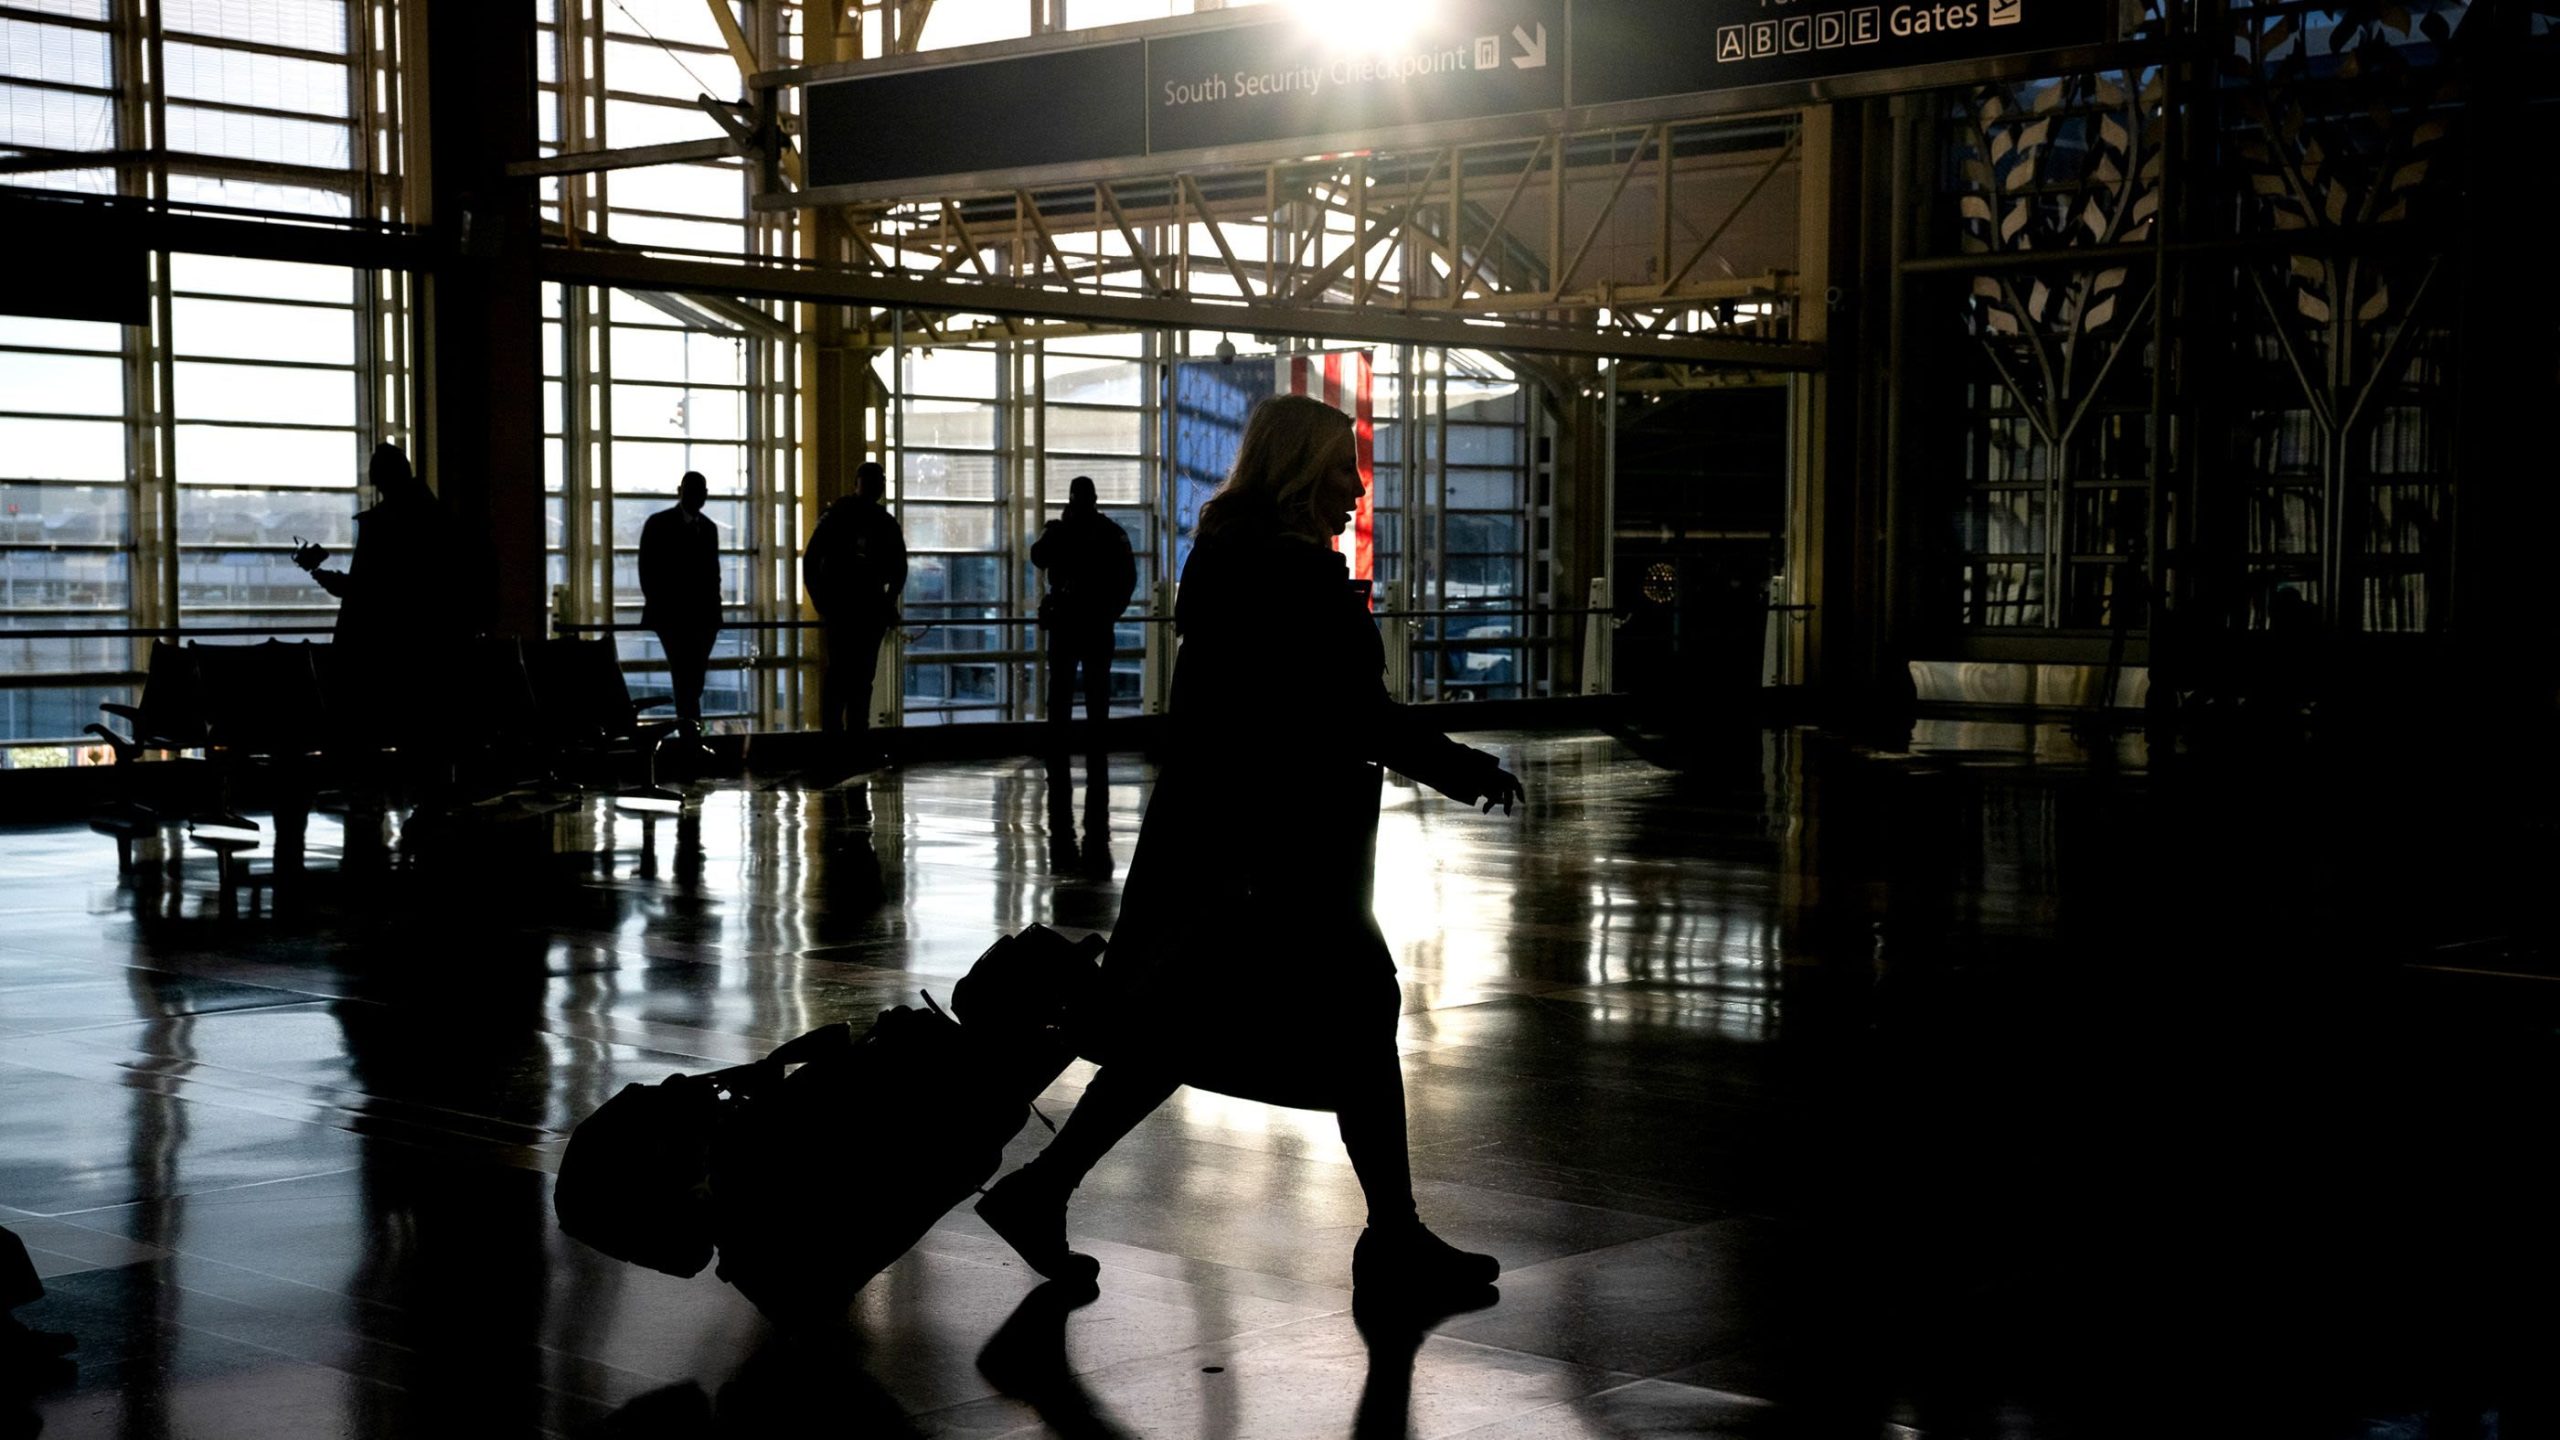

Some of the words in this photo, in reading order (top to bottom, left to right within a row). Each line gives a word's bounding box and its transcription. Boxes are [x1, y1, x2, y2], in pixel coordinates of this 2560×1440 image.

[1890, 2, 1978, 37] Gates
[1164, 73, 1226, 106] South
[1235, 66, 1323, 96] Security
[1330, 45, 1466, 84] Checkpoint
